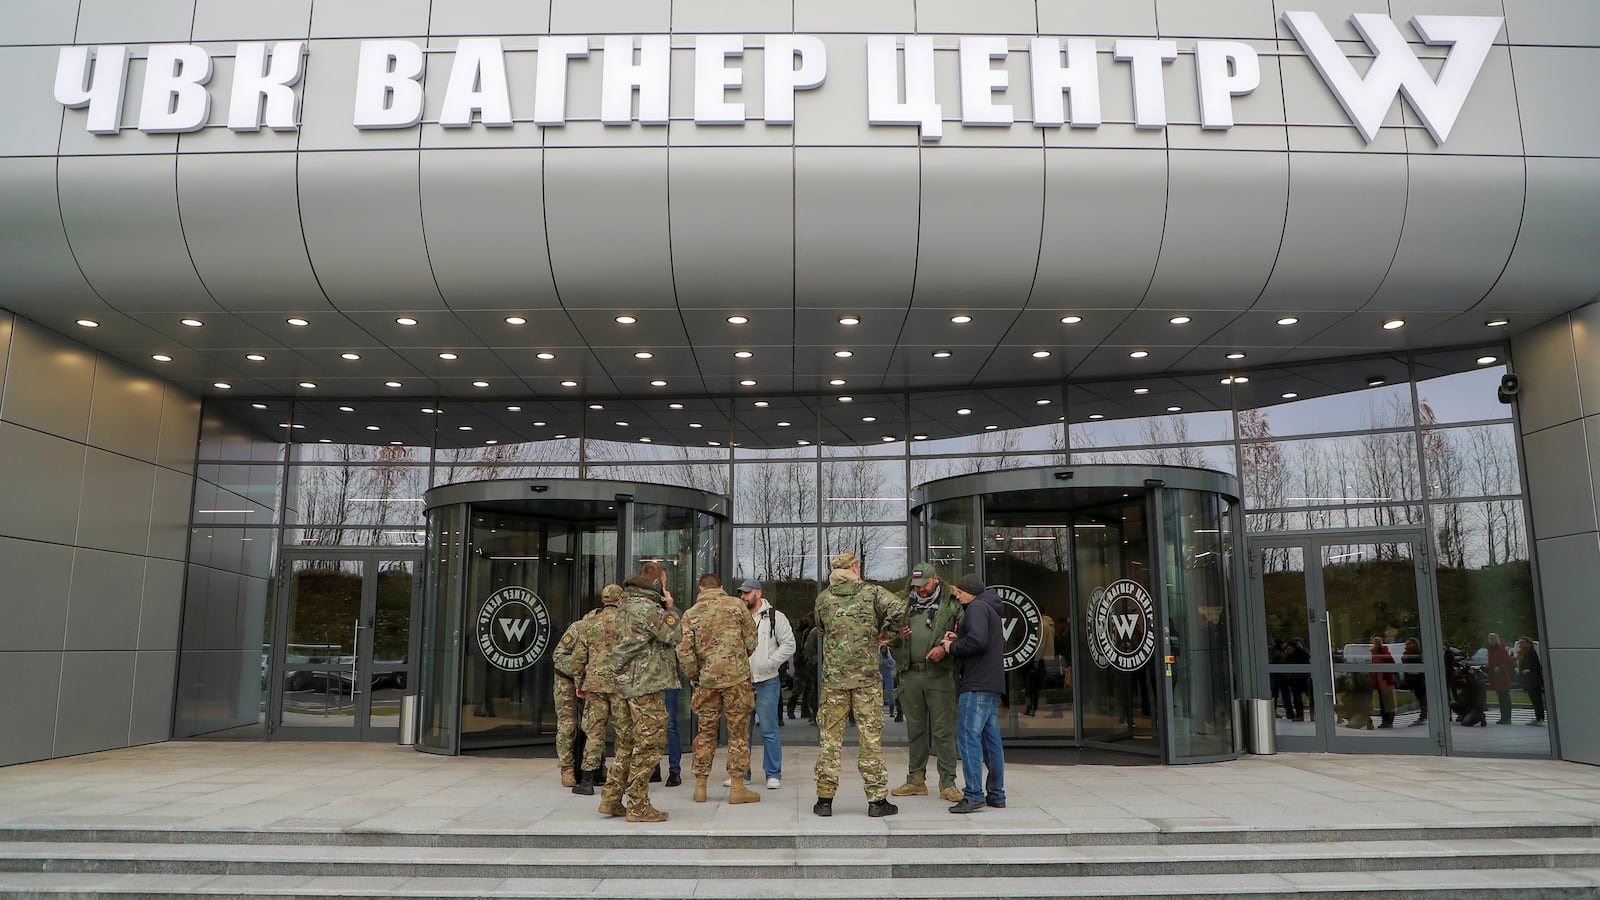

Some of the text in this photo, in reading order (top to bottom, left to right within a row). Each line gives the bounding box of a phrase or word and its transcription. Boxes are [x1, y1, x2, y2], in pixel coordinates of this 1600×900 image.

[54, 35, 1261, 141] ЧВК ВАГНЕР ЦЕНТР
[1281, 11, 1505, 146] W
[1111, 614, 1139, 640] W
[491, 652, 525, 668] ВАГНЕР
[525, 635, 546, 663] ЦЕНТР
[1014, 633, 1039, 663] ЦЕНТР
